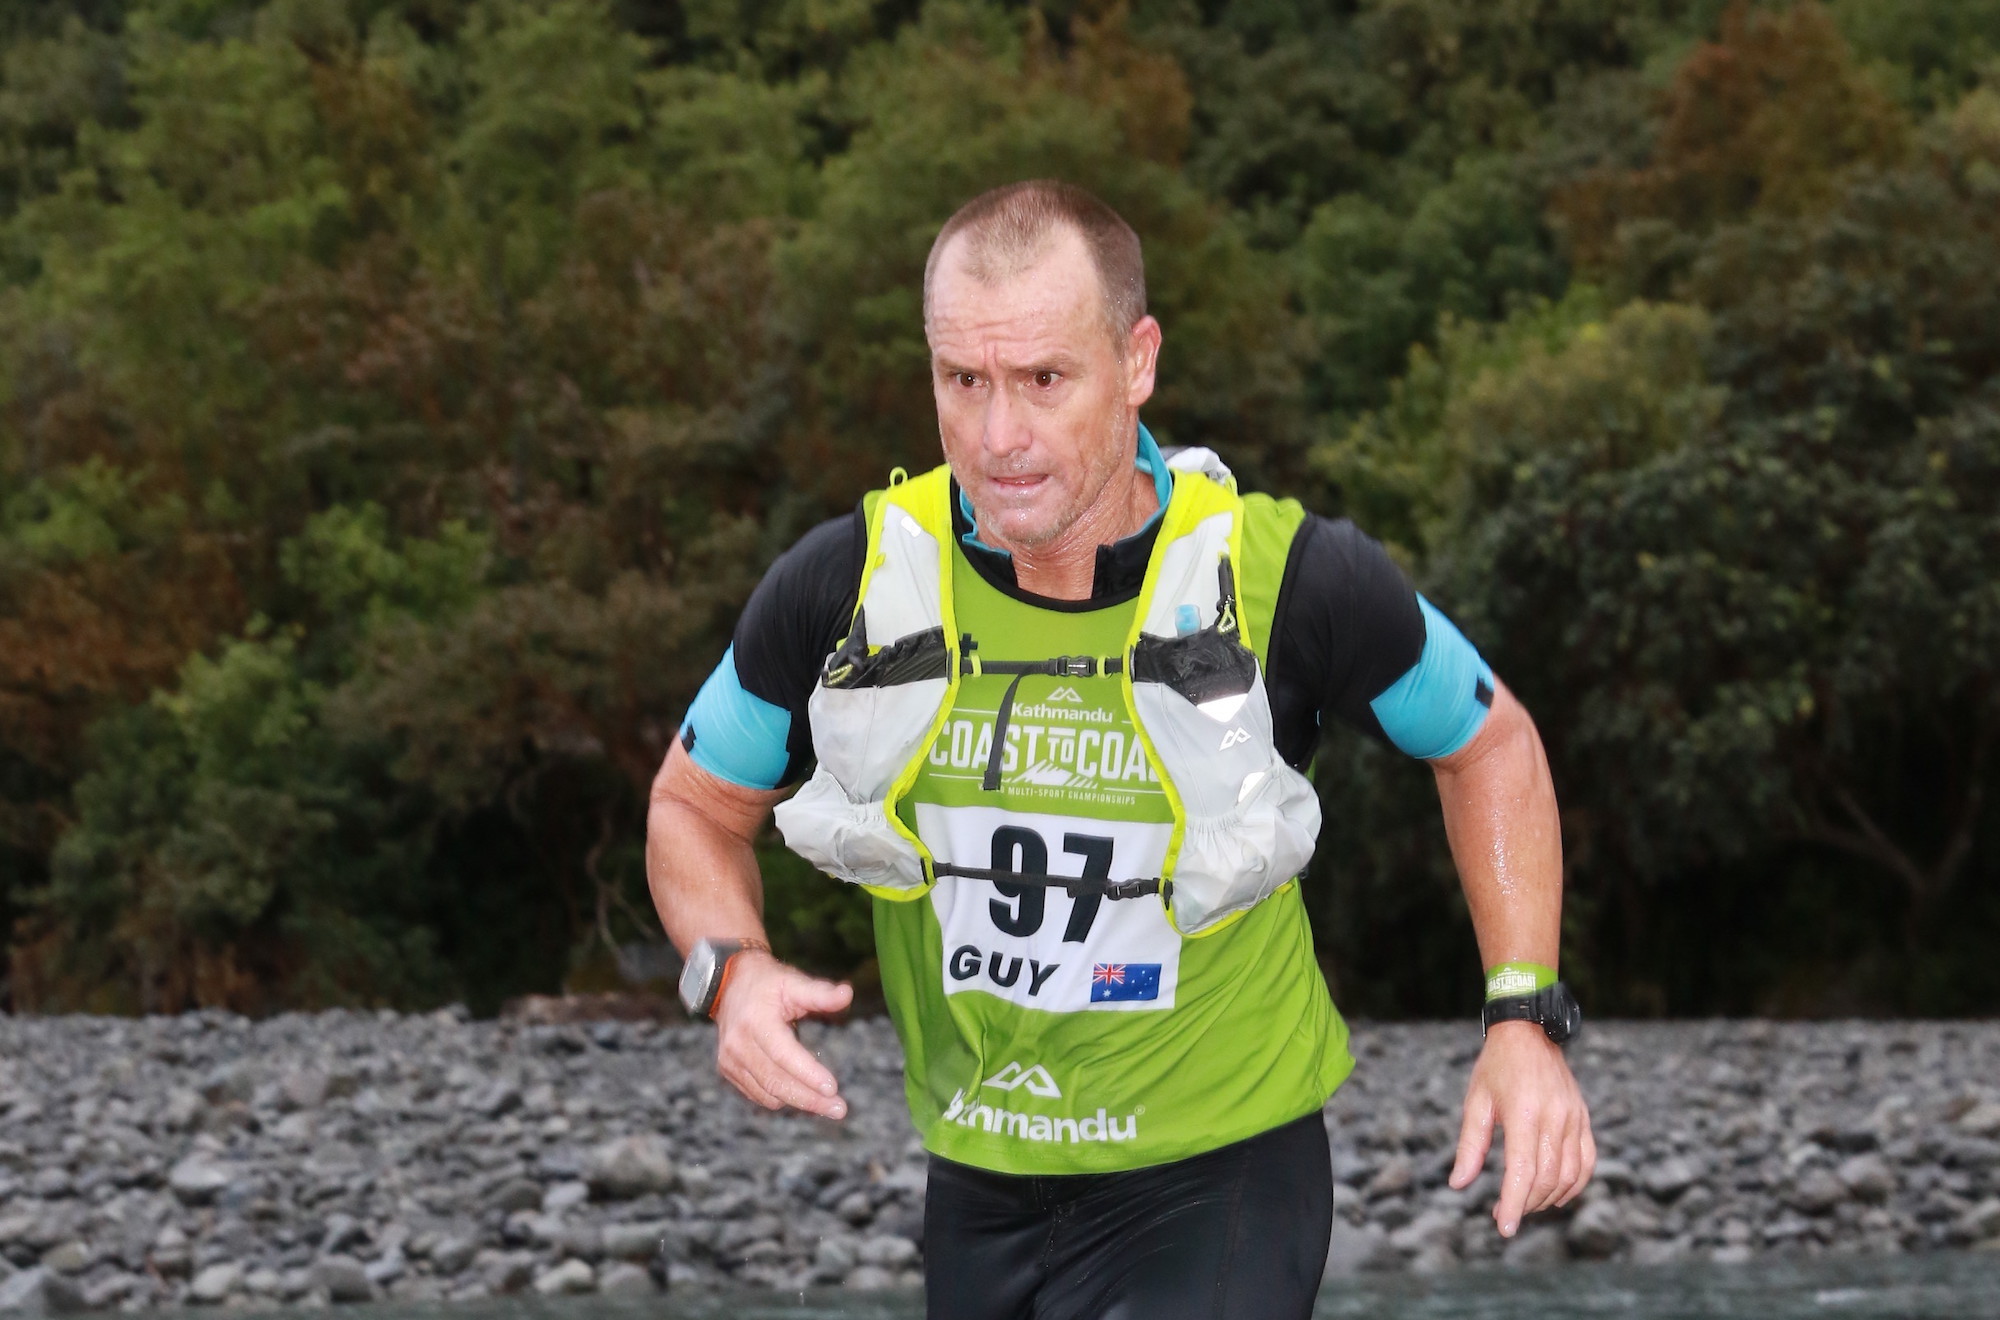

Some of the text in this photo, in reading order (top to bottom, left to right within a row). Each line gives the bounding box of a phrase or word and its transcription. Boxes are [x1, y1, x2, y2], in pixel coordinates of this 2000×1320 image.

[1012, 702, 1113, 724] Kathmandu
[1048, 736, 1075, 763] TO
[1076, 730, 1160, 782] COA
[1008, 786, 1065, 798] MULTI-SPORT
[1068, 790, 1136, 805] CHAMPIONSHIPS
[989, 825, 1114, 943] 97
[950, 945, 1061, 997] GUY
